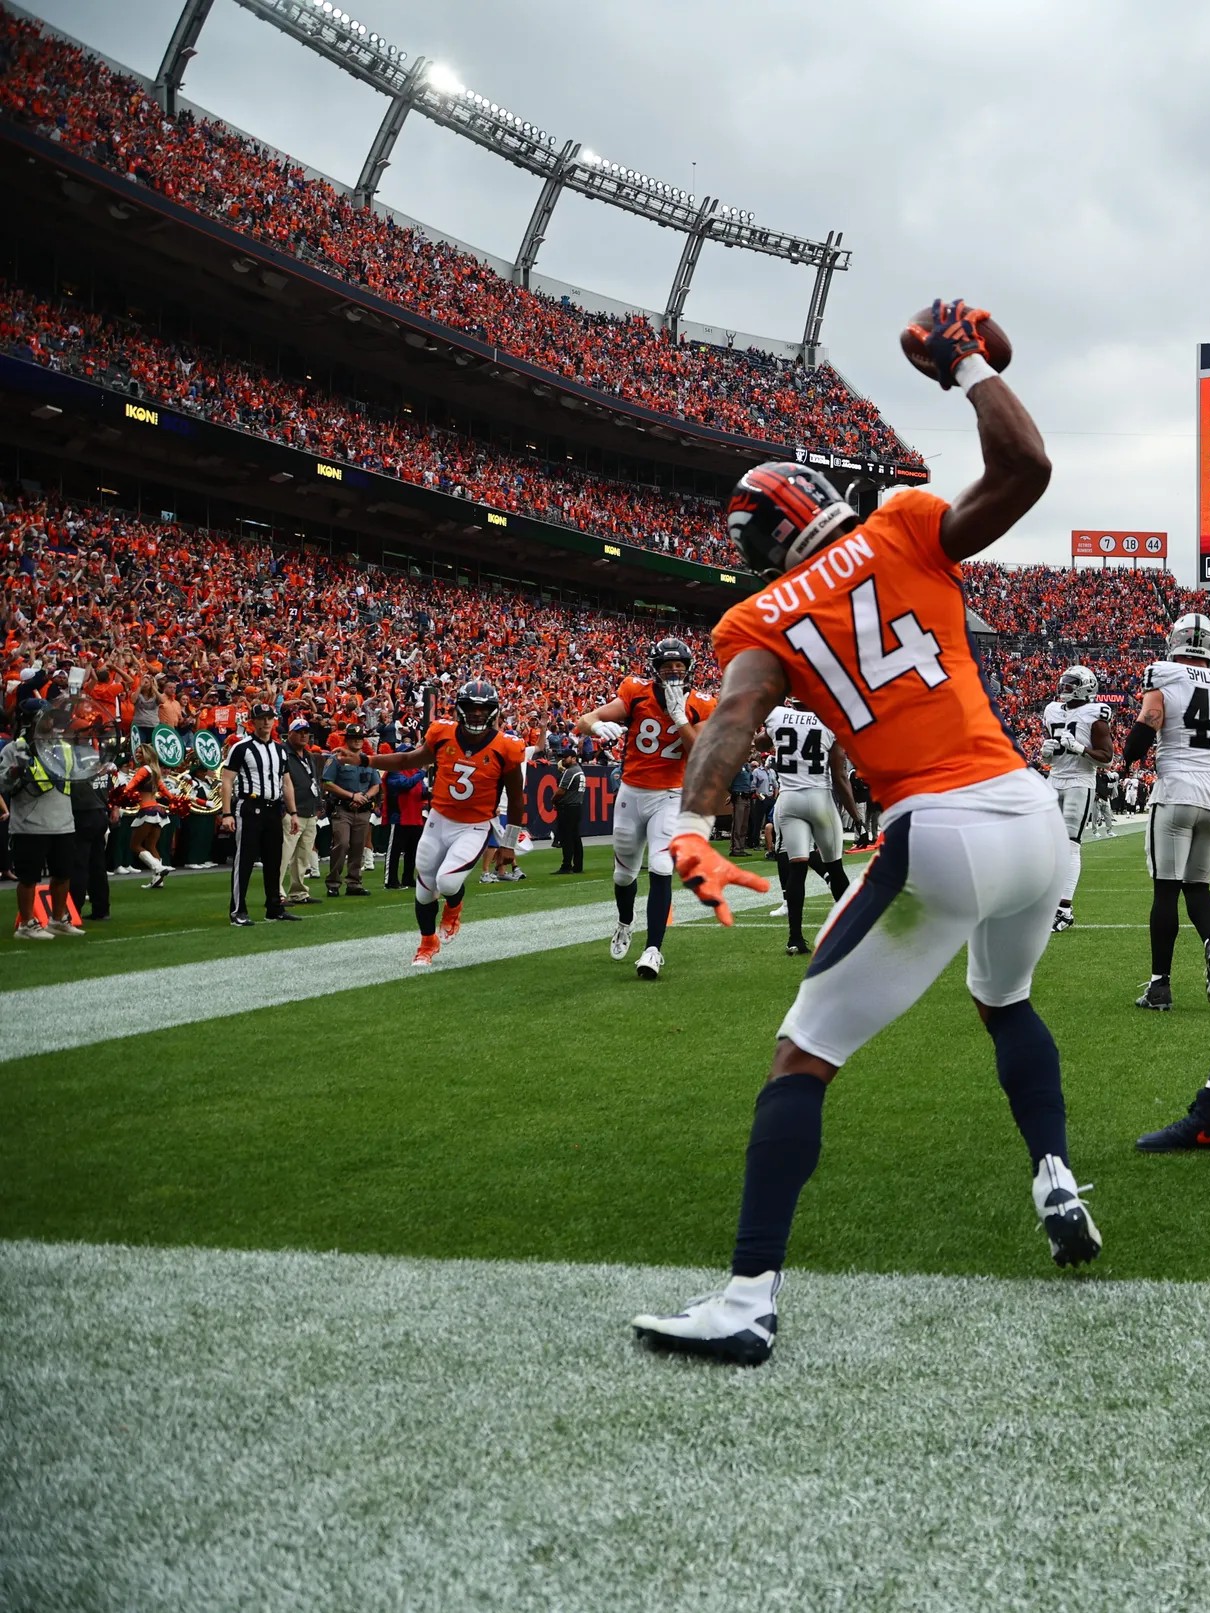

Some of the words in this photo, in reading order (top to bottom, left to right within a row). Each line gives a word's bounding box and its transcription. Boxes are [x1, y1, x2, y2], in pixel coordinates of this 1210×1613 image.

[125, 403, 155, 425] IKON
[317, 463, 338, 479] IKON
[896, 468, 927, 479] BRONCOS
[1104, 539, 1110, 549] 7
[1125, 539, 1136, 549] 18
[1147, 540, 1159, 550] 44
[756, 533, 875, 624] SUTTON
[783, 574, 950, 734] 14
[406, 718, 418, 729] 30
[782, 713, 818, 726] PETERS
[635, 718, 683, 760] 82
[775, 727, 824, 775] 24
[449, 763, 477, 801] 3
